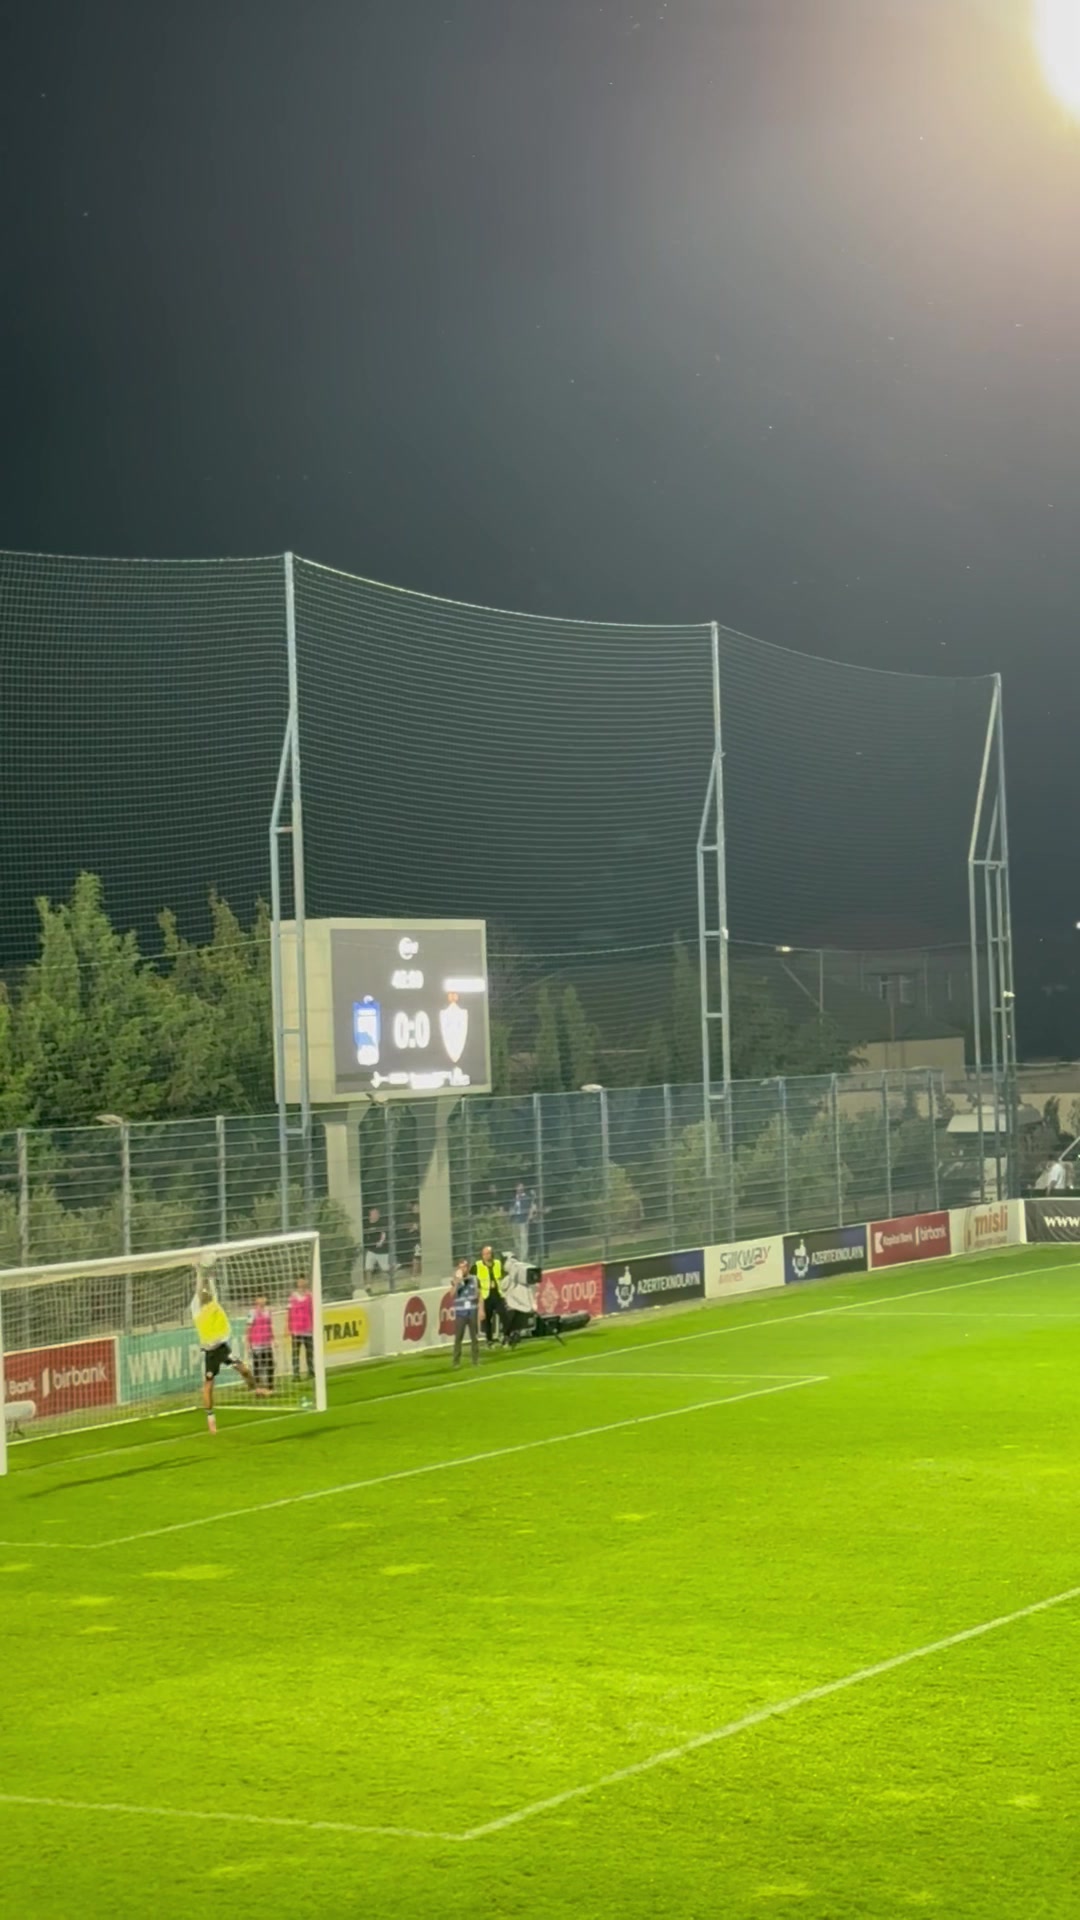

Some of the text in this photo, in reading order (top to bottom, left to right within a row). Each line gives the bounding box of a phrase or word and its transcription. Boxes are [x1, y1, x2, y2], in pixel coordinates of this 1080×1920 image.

[393, 1011, 430, 1049] 0:0
[920, 1224, 947, 1241] birbank
[975, 1205, 1008, 1236] misli
[561, 1280, 597, 1309] group
[405, 1311, 426, 1327] nar
[441, 1306, 456, 1321] na
[323, 1319, 360, 1342] TRAL
[52, 1361, 108, 1390] birbank
[127, 1343, 205, 1386] WWW.P
[8, 1377, 36, 1396] Bank
